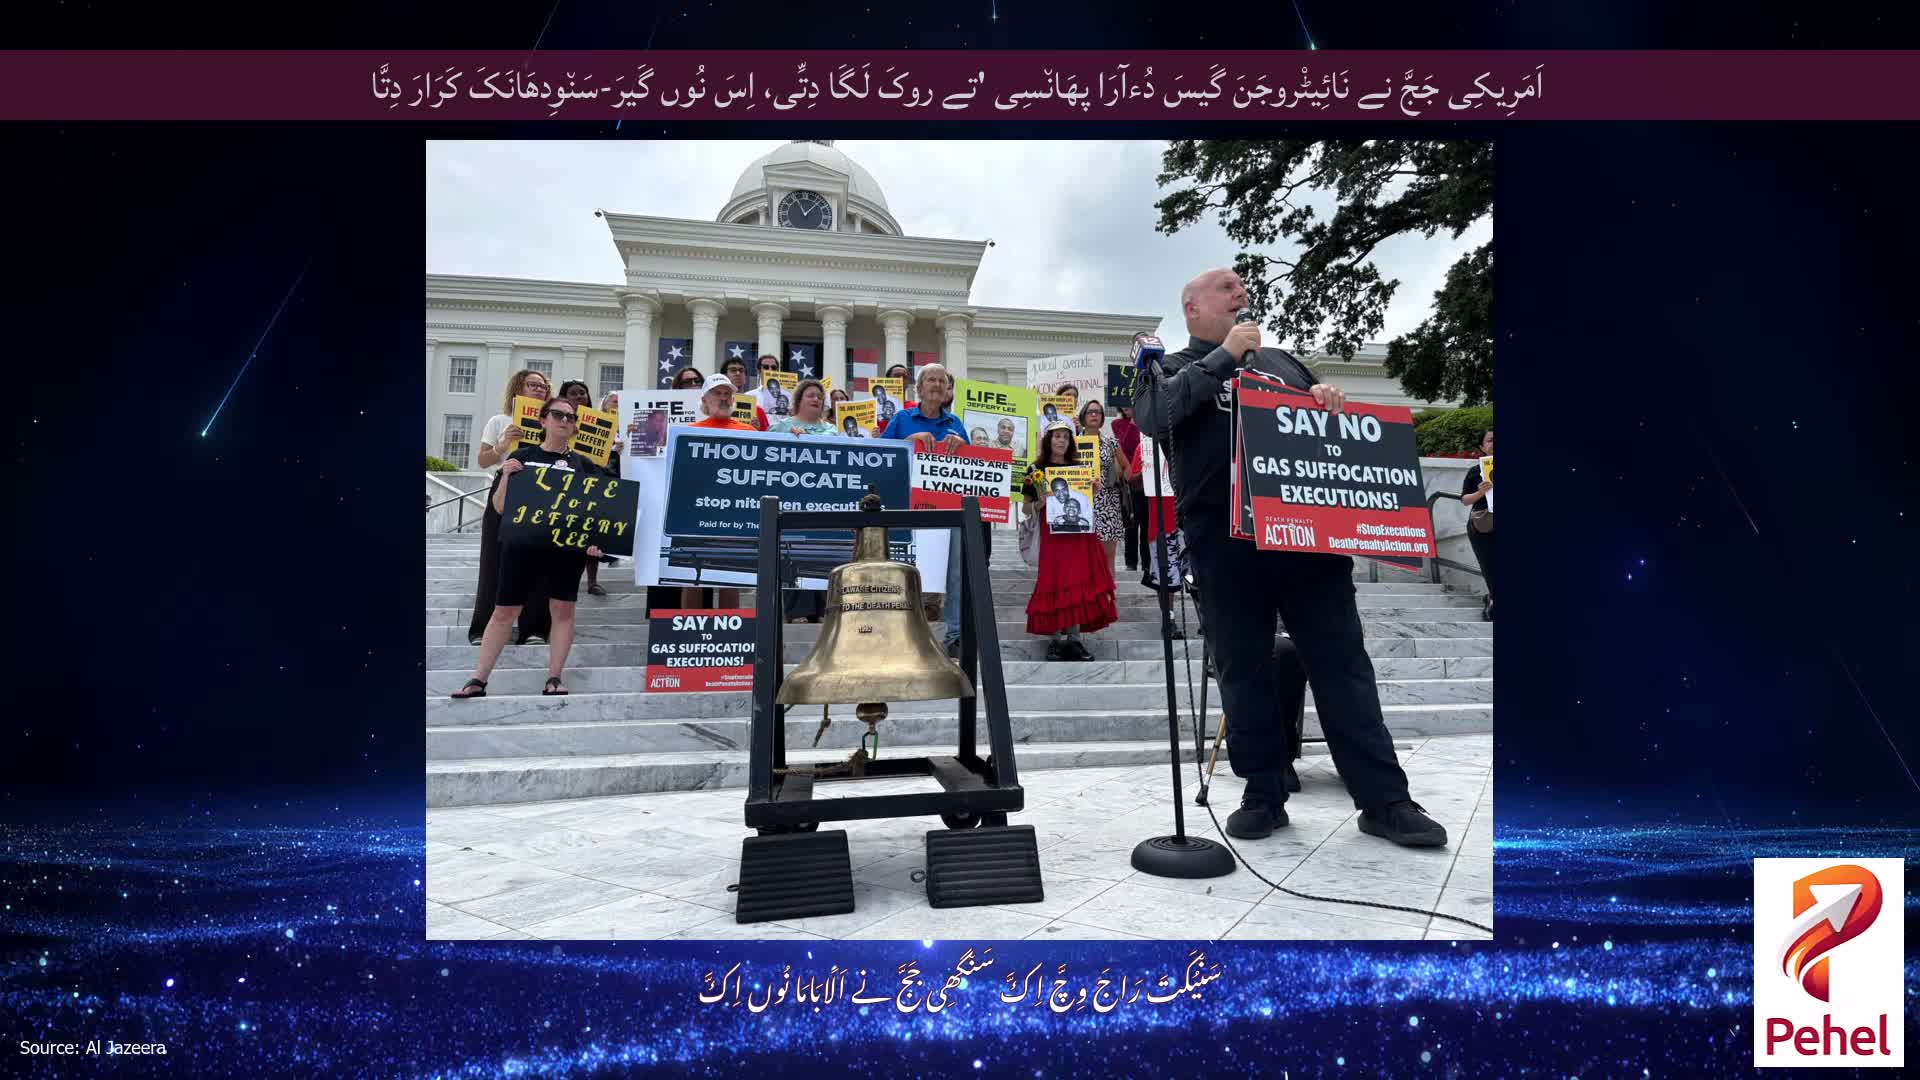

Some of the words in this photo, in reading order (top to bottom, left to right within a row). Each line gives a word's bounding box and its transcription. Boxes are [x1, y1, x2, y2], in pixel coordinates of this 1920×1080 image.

[967, 389, 1008, 406] LIFE
[522, 406, 540, 418] LIFE
[967, 402, 1001, 411] JEFFERY
[581, 412, 597, 424] LIFE
[1275, 406, 1329, 438] SAY
[1338, 412, 1382, 443] NO
[576, 433, 607, 448] JEFFERY
[596, 428, 611, 439] FOR
[592, 447, 605, 458] LEE
[687, 441, 758, 461] THOU
[764, 446, 841, 465] SHALT
[848, 450, 897, 468] NOT
[1082, 451, 1094, 459] FOR
[1324, 444, 1342, 457] TO
[917, 453, 985, 467] EXECUTIONS
[987, 460, 1009, 470] ARE
[716, 467, 869, 490] SUFFOCATE.
[920, 464, 1004, 483] LEGALIZED
[1252, 456, 1291, 477] GAS
[1294, 459, 1418, 486] SUFFOCATION
[535, 467, 619, 498] LIFE
[922, 480, 1000, 497] LYNCHING
[550, 492, 598, 511] for
[695, 496, 731, 510] stop
[735, 497, 802, 512] nitren
[805, 499, 886, 512] executis
[1280, 484, 1400, 510] EXECUTIONS!
[512, 505, 628, 536] JEFFERY
[699, 520, 717, 528] Paid
[719, 520, 731, 528] for
[733, 521, 744, 530] by
[1286, 517, 1314, 525] PENALTY
[551, 528, 590, 548] LEE
[1265, 523, 1316, 548] ACTION
[1356, 522, 1426, 538] #StopExecutions
[1328, 536, 1429, 554] DeathPenaltyAction.org
[851, 602, 865, 610] THE
[866, 601, 890, 609] DEATH
[672, 615, 708, 631] SAY
[714, 615, 743, 631] NO
[701, 633, 713, 641] TO
[651, 643, 676, 654] GAS
[666, 656, 744, 668] EXECUTIONS!
[650, 677, 680, 688] ACTION
